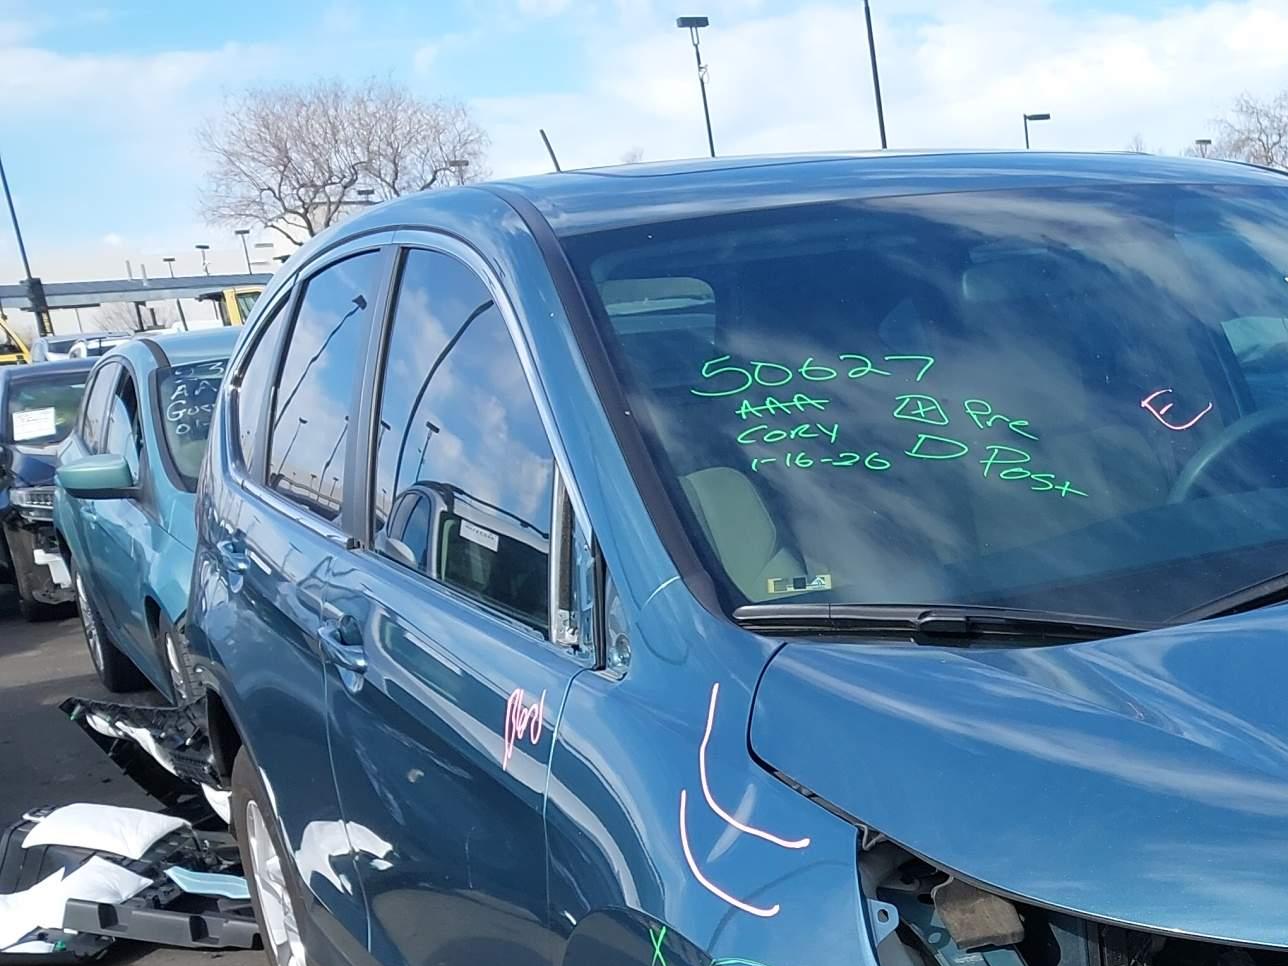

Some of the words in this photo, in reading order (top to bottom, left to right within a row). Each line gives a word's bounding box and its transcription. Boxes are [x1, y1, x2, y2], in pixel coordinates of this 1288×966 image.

[690, 354, 935, 396] 50627
[964, 399, 1041, 442] Pre
[979, 445, 1090, 498] Post
